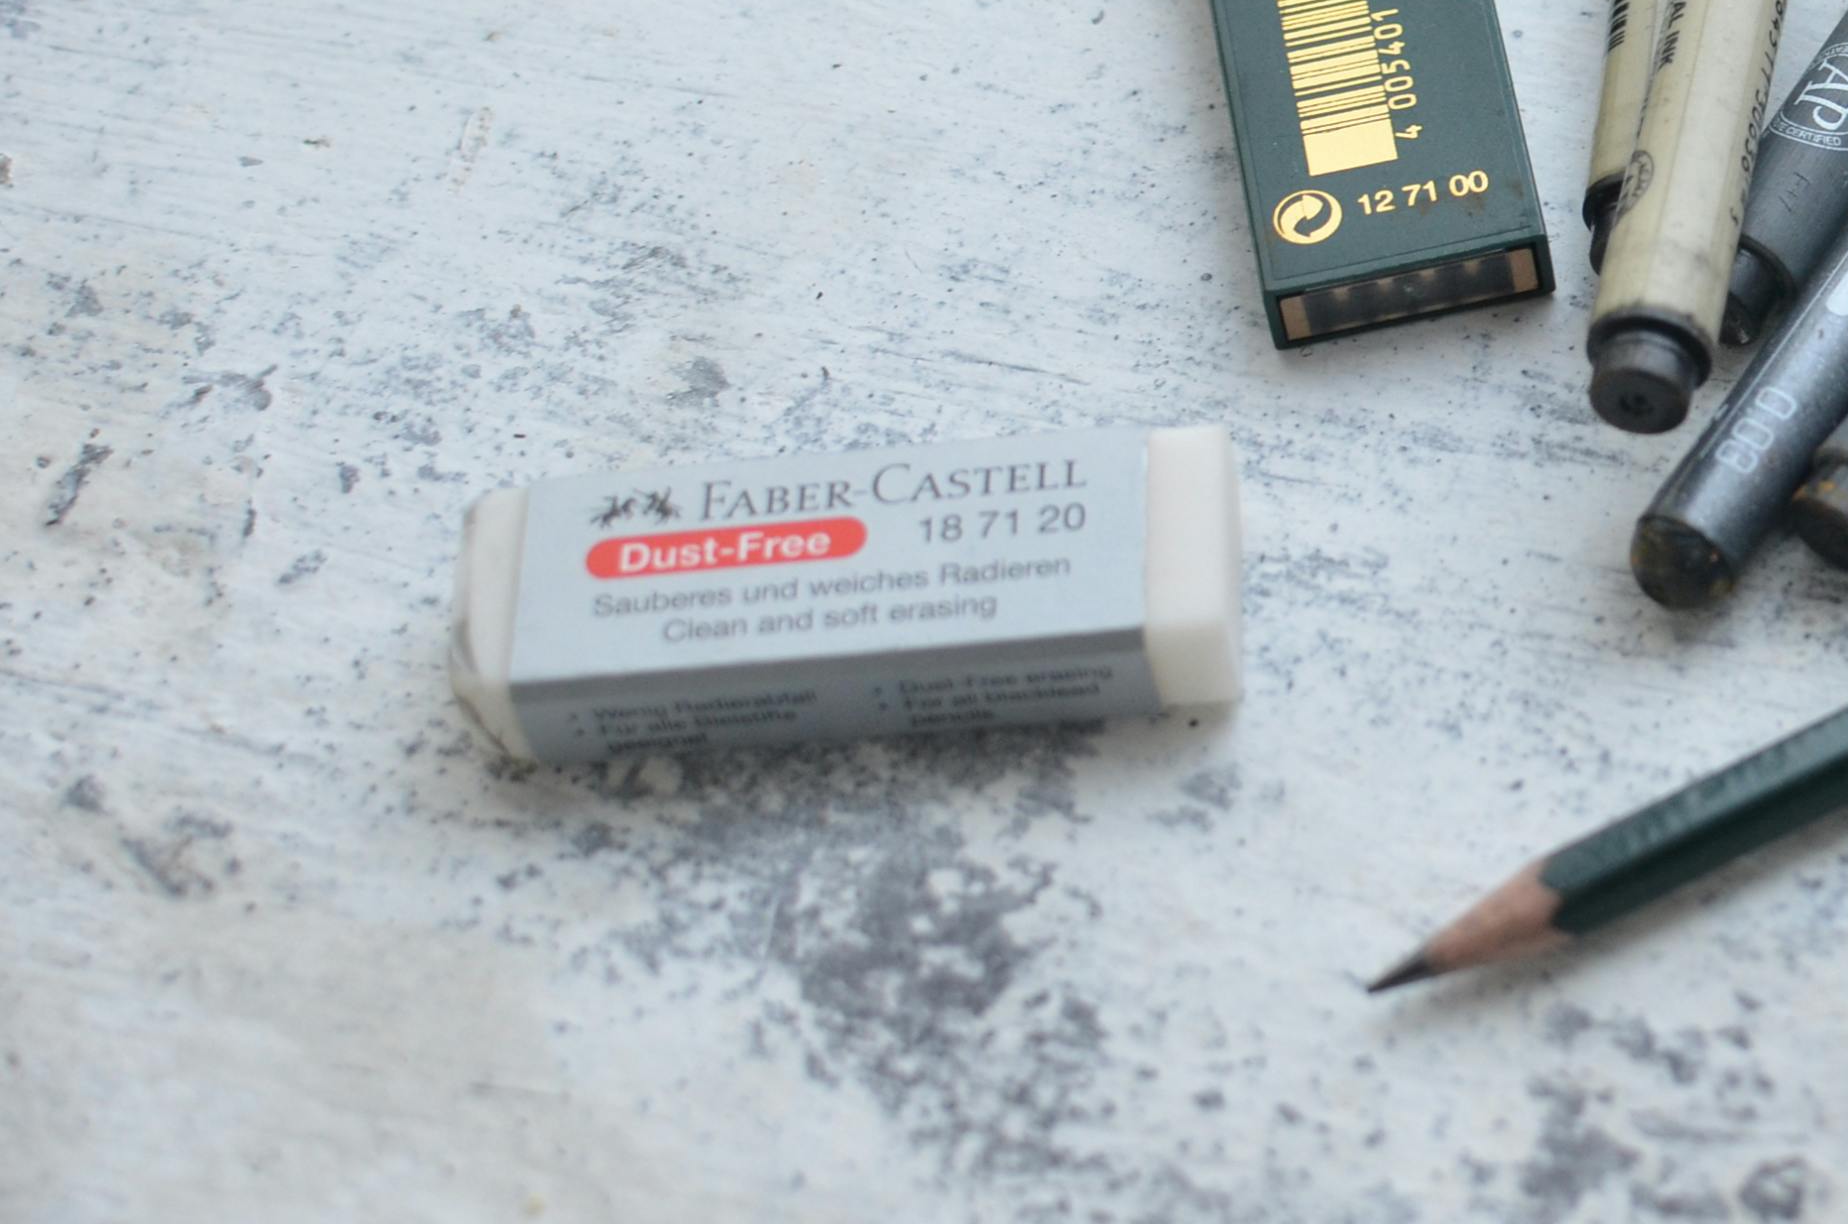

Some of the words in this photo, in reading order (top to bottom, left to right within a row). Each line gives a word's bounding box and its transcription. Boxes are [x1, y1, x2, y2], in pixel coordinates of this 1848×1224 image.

[1376, 8, 1418, 111] 005401
[1656, 29, 1679, 74] INK
[1396, 122, 1423, 141] 4
[1356, 188, 1397, 217] 12
[1400, 179, 1439, 208] 71
[1446, 168, 1490, 198] 00
[701, 459, 1087, 520] FABER-CASTELL
[920, 512, 962, 544] 18
[978, 507, 1021, 539] 71
[1039, 502, 1086, 535] 20
[618, 528, 831, 573] Dust-Free
[593, 584, 733, 620] Sauberes
[742, 577, 800, 606] und
[808, 566, 929, 597] weiches
[938, 553, 1071, 586] Radieren
[661, 614, 748, 644] Clean
[758, 608, 815, 636] and
[823, 600, 879, 629] soft
[888, 594, 997, 626] erasing
